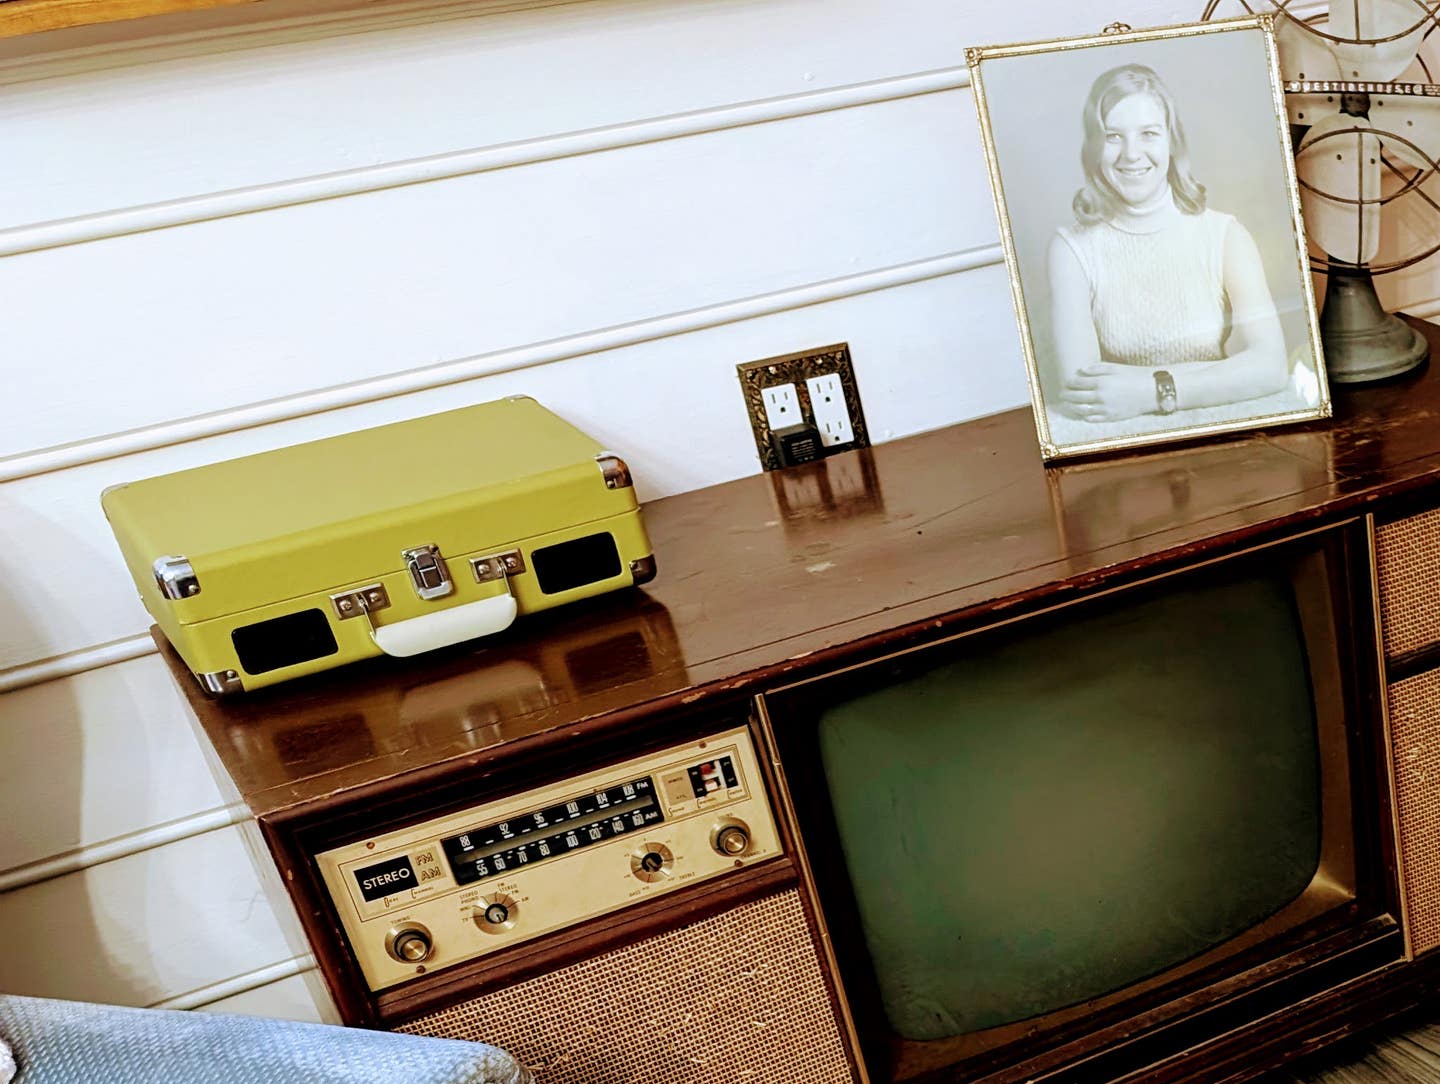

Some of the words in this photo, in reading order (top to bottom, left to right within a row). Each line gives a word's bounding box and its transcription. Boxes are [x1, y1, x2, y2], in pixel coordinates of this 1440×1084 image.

[460, 835, 471, 847] 88
[499, 823, 510, 835] 92
[533, 812, 545, 825] 96
[636, 781, 649, 790] FM
[476, 863, 488, 876] 55
[494, 858, 506, 871] 60
[516, 850, 528, 864] 70
[539, 843, 550, 857] 80
[645, 810, 659, 820] AM
[415, 852, 434, 866] FM
[362, 867, 410, 890] STEREO
[420, 866, 441, 882] AM
